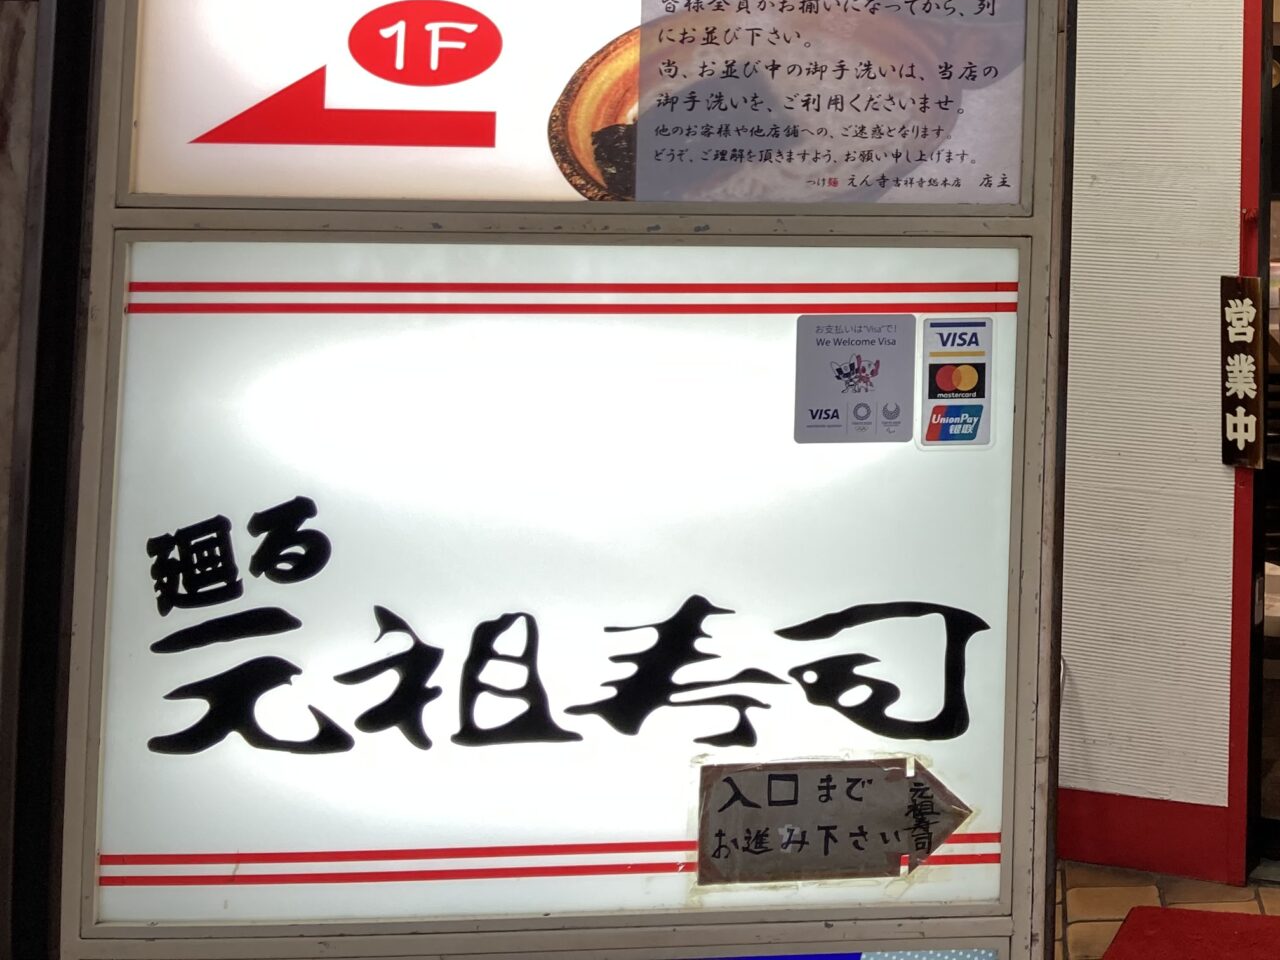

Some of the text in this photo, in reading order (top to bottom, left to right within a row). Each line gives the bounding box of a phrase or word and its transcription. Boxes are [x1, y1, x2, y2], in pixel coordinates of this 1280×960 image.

[377, 20, 479, 72] 1F
[657, 26, 813, 49] にお並び下さい。
[656, 92, 966, 116] 御手洗いを、ご利用くださいませ。
[815, 337, 897, 347] We Welcome Visa
[936, 332, 980, 347] VISA
[1224, 297, 1258, 452] 営業中
[937, 391, 977, 399] mastercard
[808, 409, 840, 420] VISA
[932, 414, 979, 427] UnionPay
[147, 494, 331, 616] 廻る
[147, 594, 991, 754] 元祖寿司
[717, 773, 874, 813] 入口まで
[904, 781, 941, 855] 元祖寿司
[711, 824, 901, 859] お進み下さい
